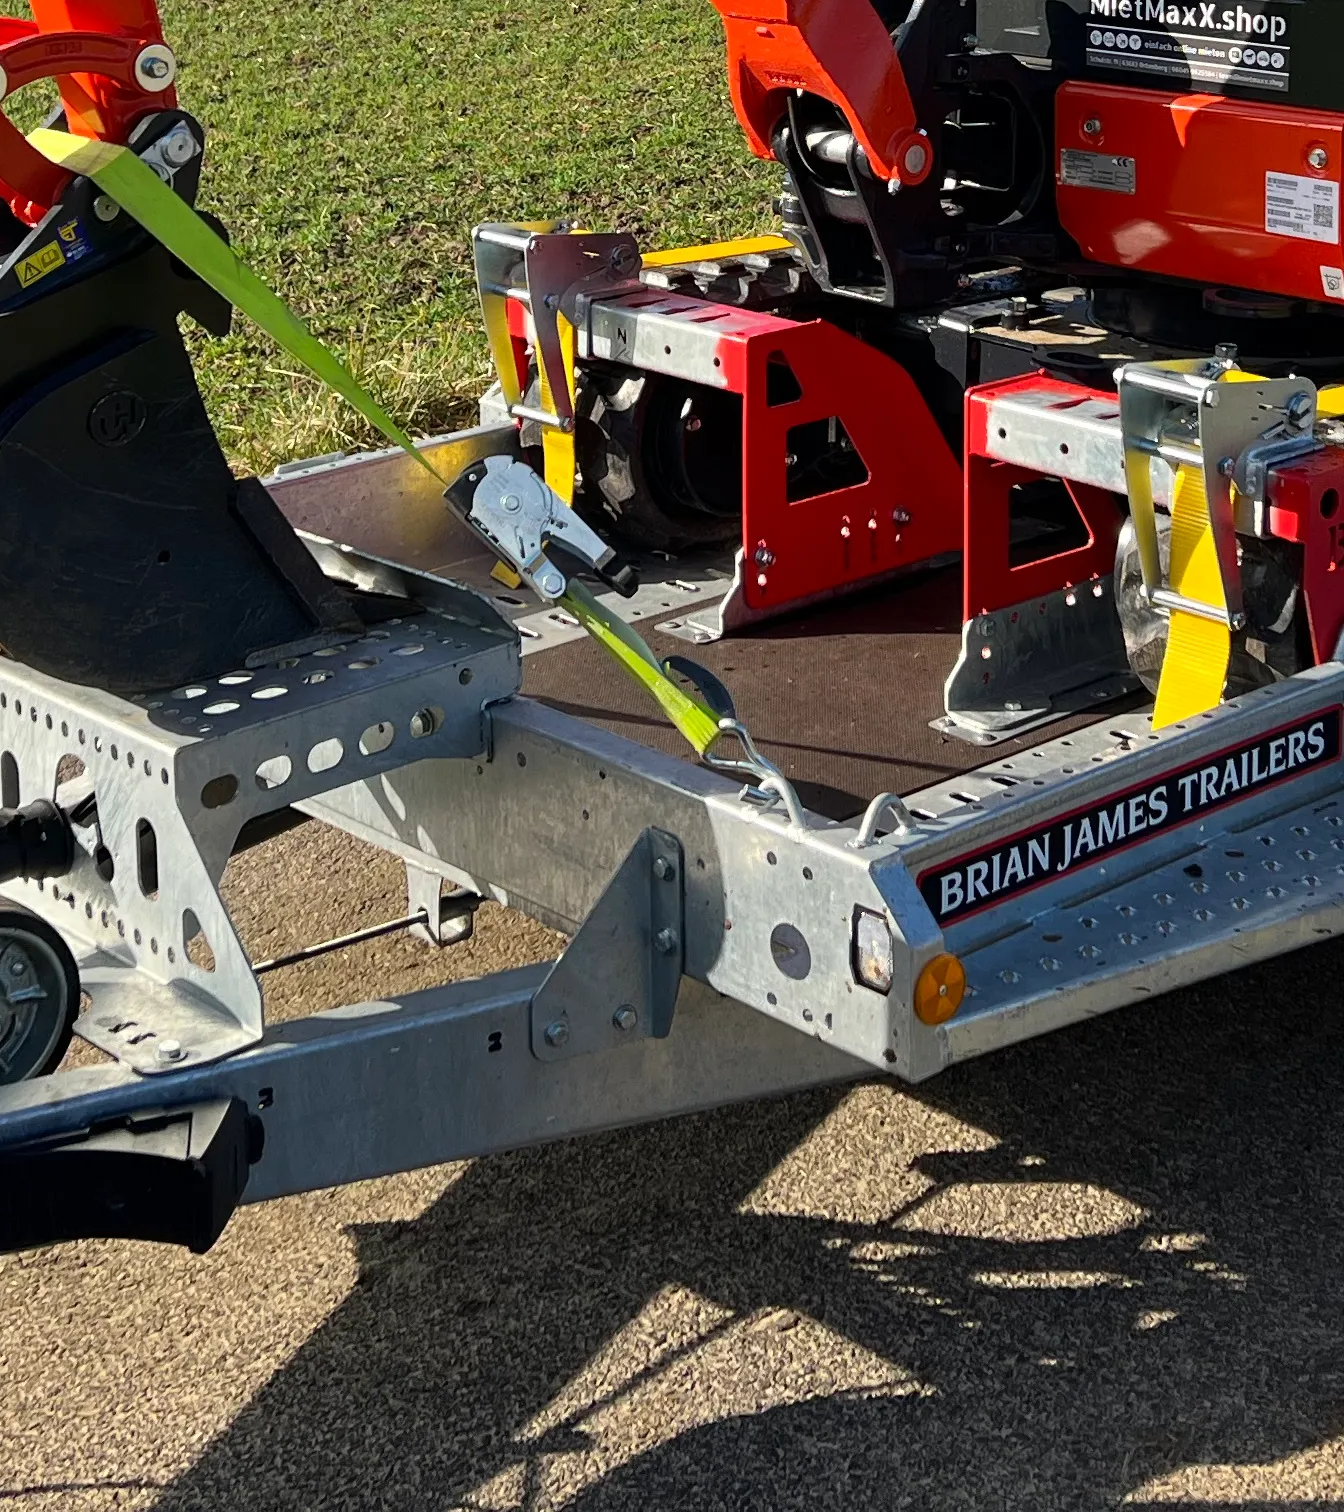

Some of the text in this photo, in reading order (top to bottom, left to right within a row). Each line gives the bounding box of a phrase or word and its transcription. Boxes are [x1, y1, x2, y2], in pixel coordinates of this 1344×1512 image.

[1144, 40, 1225, 58] einfach online mieten
[939, 721, 1326, 914] BRIAN JAMES TRAILERS
